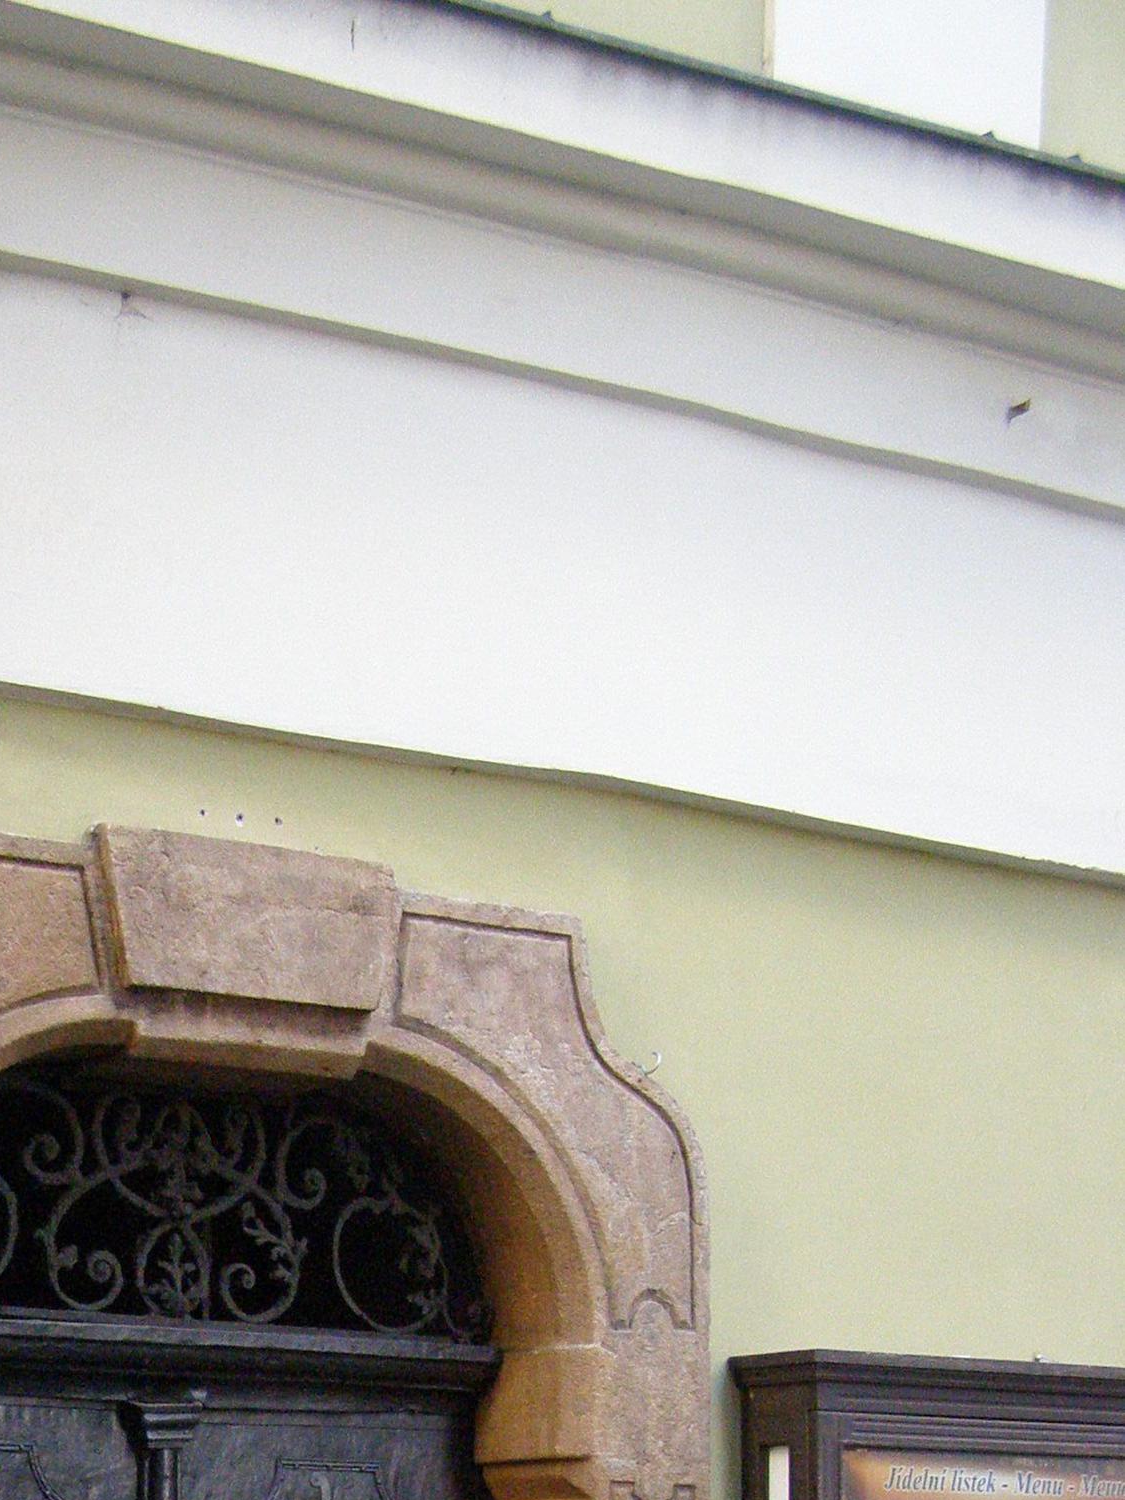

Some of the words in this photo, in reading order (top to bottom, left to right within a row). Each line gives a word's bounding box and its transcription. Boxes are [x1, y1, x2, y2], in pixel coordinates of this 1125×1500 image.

[884, 1465, 948, 1492] Jídelní
[951, 1468, 996, 1493] lístek
[1016, 1471, 1063, 1496] Menu
